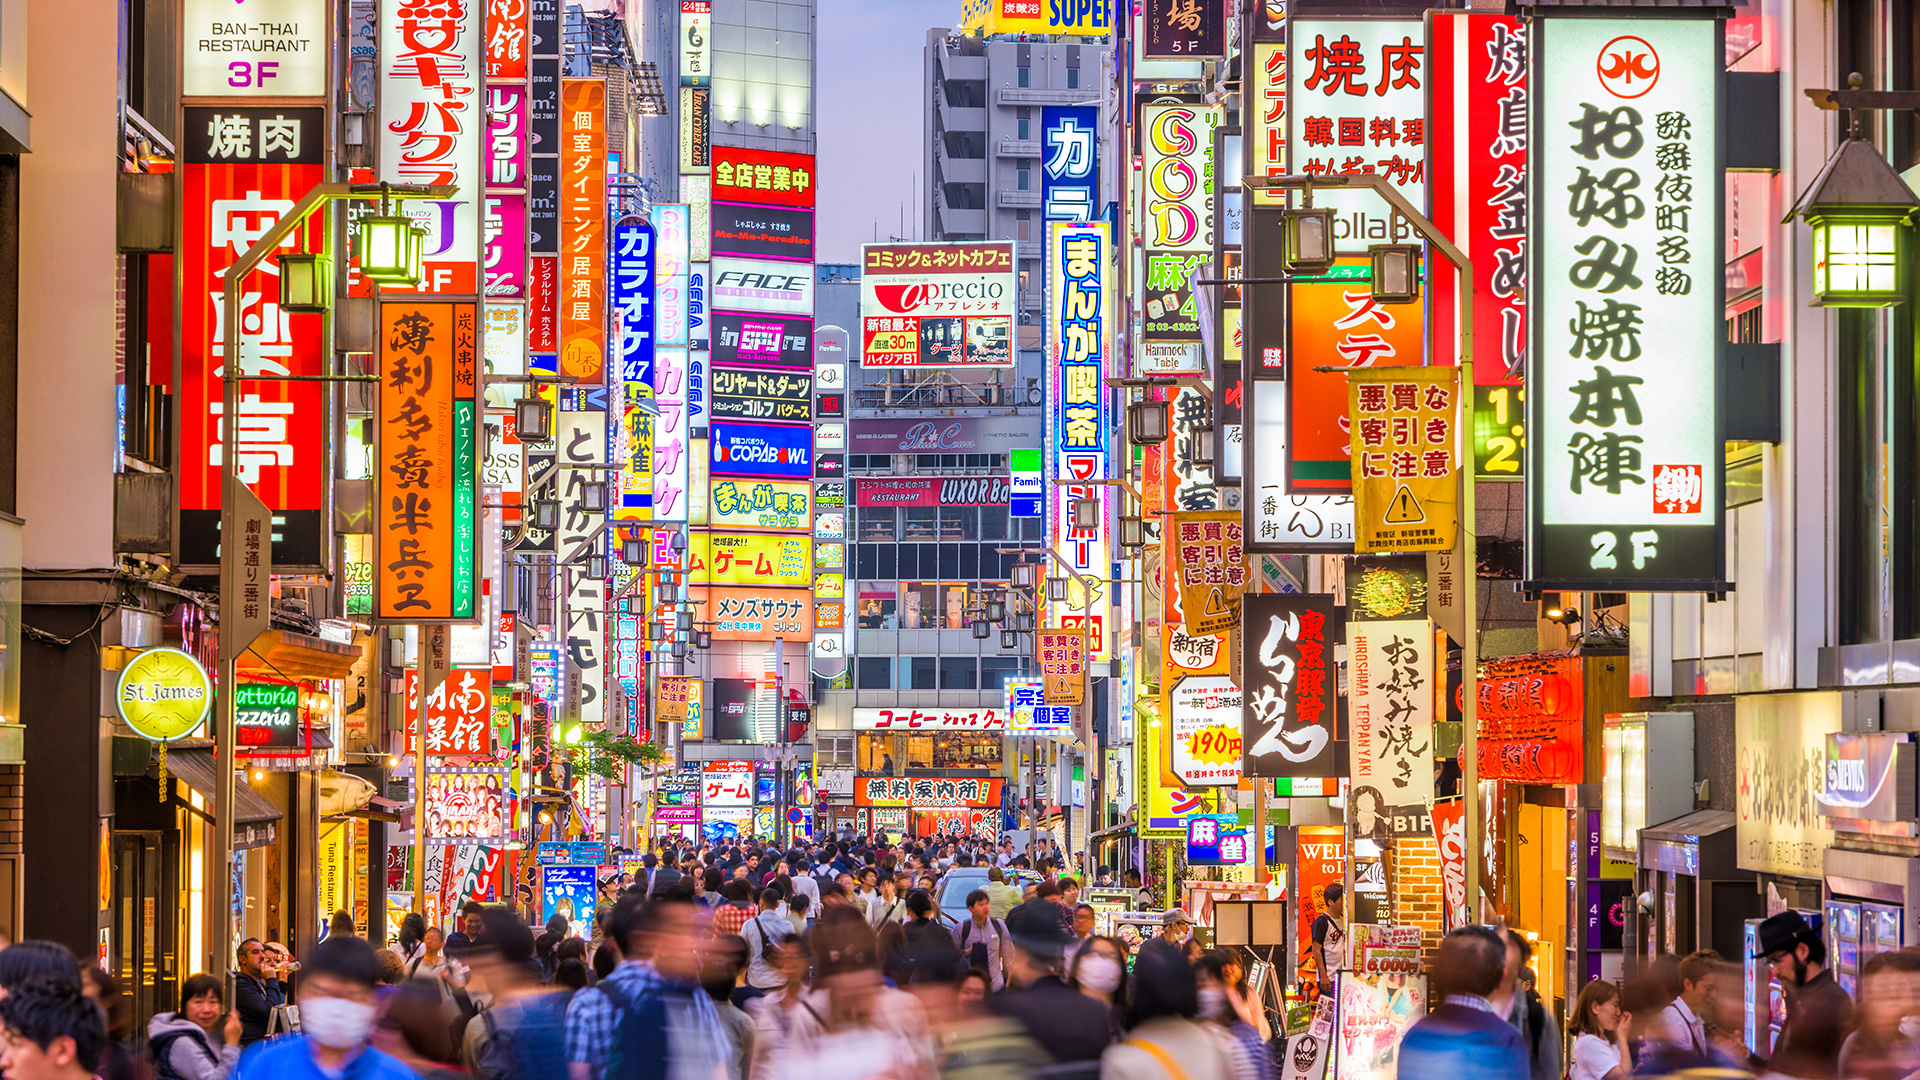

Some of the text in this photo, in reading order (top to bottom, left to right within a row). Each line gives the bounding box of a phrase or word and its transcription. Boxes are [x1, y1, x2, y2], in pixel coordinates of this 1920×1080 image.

[1003, 2, 1040, 14] 炭酸浴
[212, 23, 298, 36] BAN-THAI
[199, 40, 310, 52] RESTAURANT
[1172, 40, 1199, 53] 5F
[228, 62, 279, 88] 3F
[1156, 83, 1179, 94] 6F
[208, 114, 301, 159] 焼肉
[492, 89, 519, 183] レンタル
[1303, 115, 1424, 148] 韓国料理
[715, 160, 810, 193] 全店営業中
[571, 110, 592, 321] 個室ダイニング居酒屋
[1655, 111, 1692, 296] 歌舞伎町名物
[735, 219, 766, 230] しゃぶしゃぶ
[715, 230, 811, 245] Mo-Mo-Paradise
[867, 249, 1011, 268] コミック&ネットカフェ
[618, 228, 650, 356] カラオケ
[716, 271, 810, 292] FACE
[540, 258, 551, 347] レンタルルーム ホステル
[690, 273, 703, 329] SEGA
[934, 301, 1001, 311] アプレシオ
[1567, 101, 1646, 496] お好み焼本陣
[866, 317, 918, 332] 新宿最大
[455, 313, 475, 387] 炭火串焼
[930, 343, 962, 355] ダーツ
[1064, 237, 1099, 448] まんが喫茶
[1145, 343, 1188, 357] Hammock
[866, 352, 918, 365] ハイジアB1
[1154, 357, 1180, 368] Table
[690, 360, 703, 417] SEGA
[713, 371, 810, 398] ビリヤード&ダーツ
[1358, 383, 1451, 413] 悪質な
[776, 403, 810, 418] バグース
[631, 410, 651, 474] 麻雀
[655, 357, 683, 516] カラオケ
[1359, 416, 1449, 447] 客引き
[1361, 449, 1451, 480] に注意
[938, 477, 990, 506] LUXOR
[1654, 464, 1701, 505] 鋤
[713, 481, 807, 516] まんが喫茶
[871, 493, 921, 503] RESTAURANT
[1664, 502, 1689, 514] すき
[456, 426, 472, 595] エノケン流れる 楽しいお店
[1260, 483, 1280, 541] 一番街
[713, 537, 748, 548] 地域最大!!
[1590, 529, 1660, 570] 2F
[713, 549, 775, 577] ゲーム
[1181, 544, 1243, 566] 客引き
[243, 518, 262, 619] 劇場通り一番街
[1183, 565, 1245, 588] に注意
[817, 582, 842, 591] ゲーム
[716, 596, 804, 620] メンズサウナ
[1042, 635, 1081, 648] 悪質な
[1172, 632, 1216, 657] 新宿
[1042, 649, 1081, 662] 客引き
[1186, 655, 1203, 668] の
[1296, 608, 1326, 724] 東京豚骨
[1354, 636, 1369, 698] HIROSHIMA
[1043, 663, 1081, 676] に注意
[236, 686, 297, 706] attoria
[875, 709, 978, 728] コーヒー ショップ
[1032, 707, 1071, 725] 個室
[1376, 634, 1429, 788] お好み焼き
[1191, 730, 1242, 755] 190円
[707, 781, 751, 798] ゲーム
[866, 777, 979, 801] 無料案内所
[1393, 815, 1432, 833] B1F
[327, 842, 337, 864] Tuna
[1190, 817, 1247, 865] 麻雀
[1322, 863, 1335, 874] to
[1367, 957, 1419, 975] 6,000円
